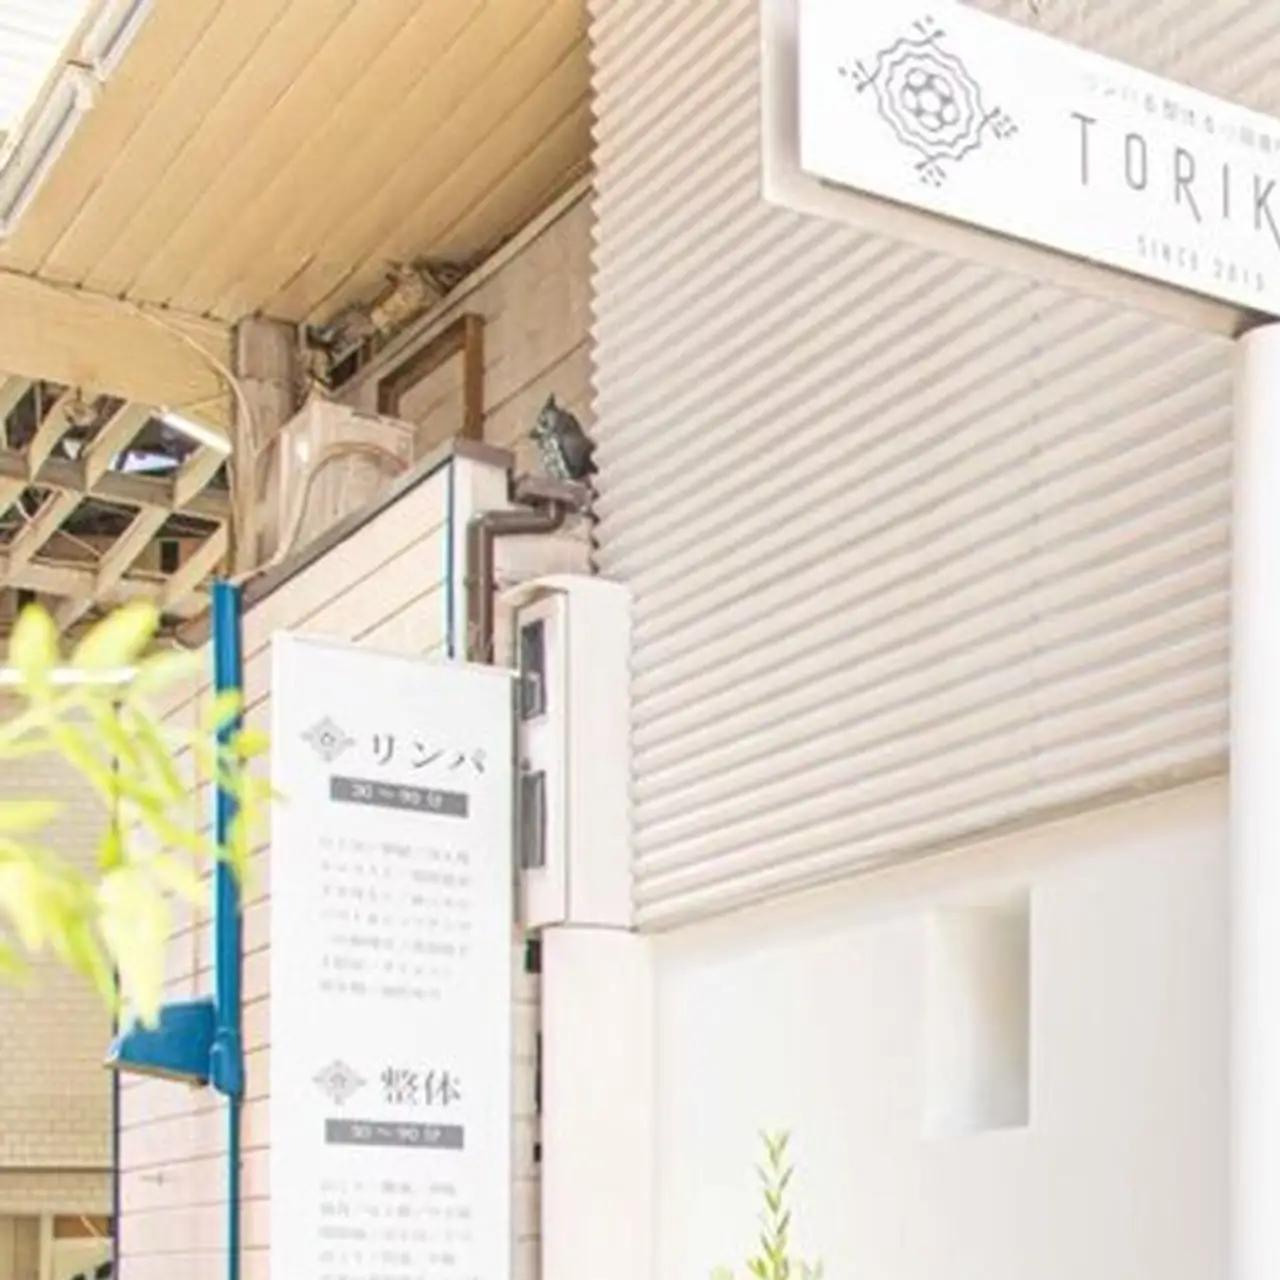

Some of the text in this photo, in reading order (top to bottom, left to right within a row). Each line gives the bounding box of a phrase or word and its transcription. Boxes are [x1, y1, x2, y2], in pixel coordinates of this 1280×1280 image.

[372, 733, 485, 775] リンパ
[381, 1066, 461, 1106] 整体
